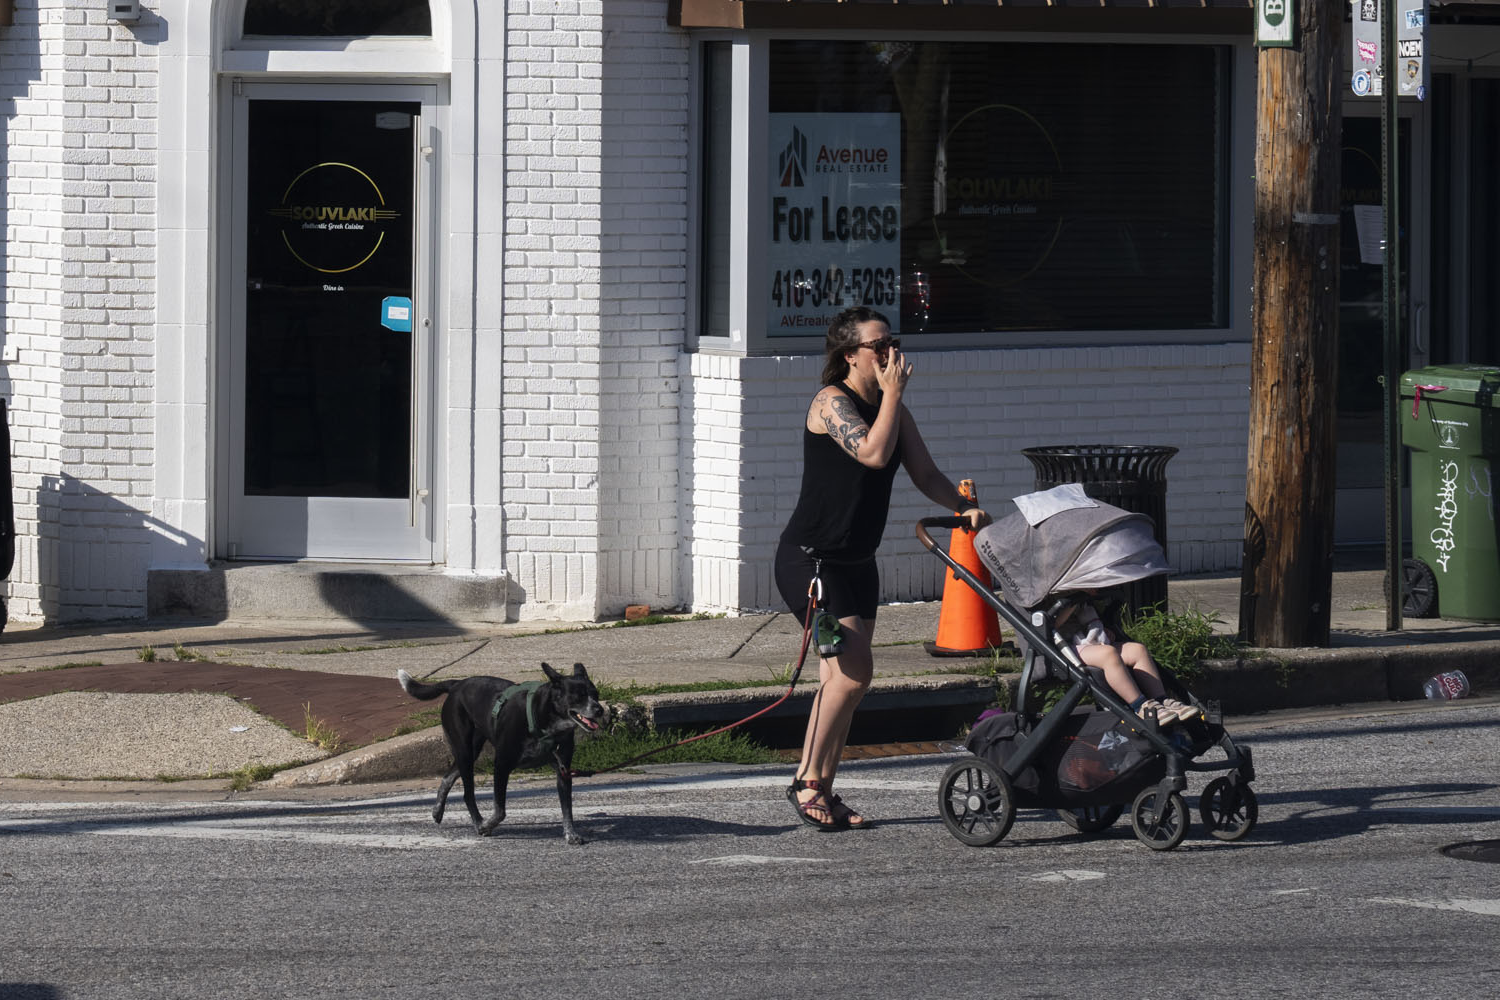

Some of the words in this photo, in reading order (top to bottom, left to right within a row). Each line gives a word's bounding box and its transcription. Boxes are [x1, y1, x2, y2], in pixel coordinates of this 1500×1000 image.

[816, 145, 889, 164] Avenue
[815, 164, 843, 173] REAL
[850, 164, 889, 173] ESTATE
[292, 206, 374, 222] SOUVLAKI
[772, 196, 814, 242] For
[821, 196, 897, 242] Lease
[771, 267, 896, 308] 410-342-5263
